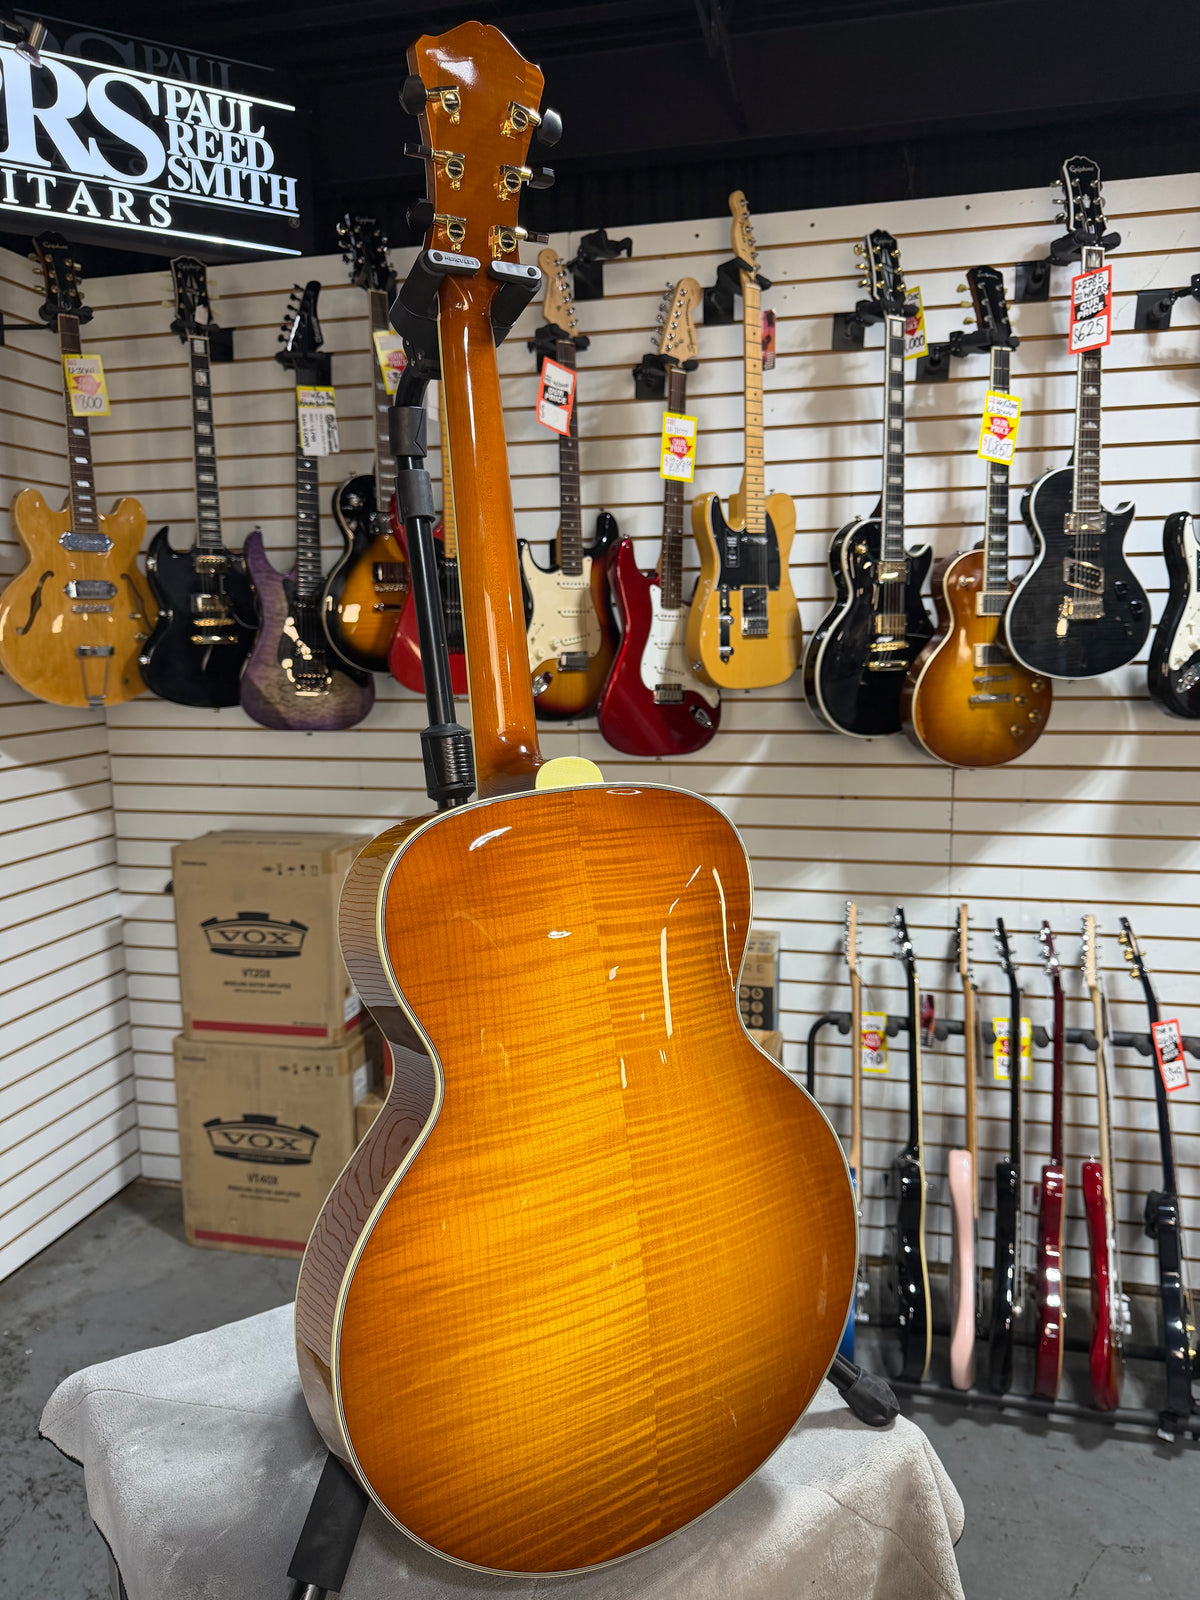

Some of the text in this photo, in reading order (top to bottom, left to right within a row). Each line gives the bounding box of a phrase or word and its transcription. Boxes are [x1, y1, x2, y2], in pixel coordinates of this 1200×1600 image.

[0, 48, 166, 184] RS
[162, 83, 266, 139] PAUL
[164, 119, 275, 172] REED
[166, 154, 299, 212] SMITH
[1077, 302, 1105, 321] PRICE
[1080, 296, 1100, 311] OUR
[1074, 317, 1105, 344] $625
[543, 391, 568, 405] PRICE
[547, 386, 565, 398] OUR
[990, 424, 1011, 435] PRICE
[993, 417, 1009, 427] OUR
[215, 929, 294, 945] VOX
[220, 1131, 302, 1151] VOX
